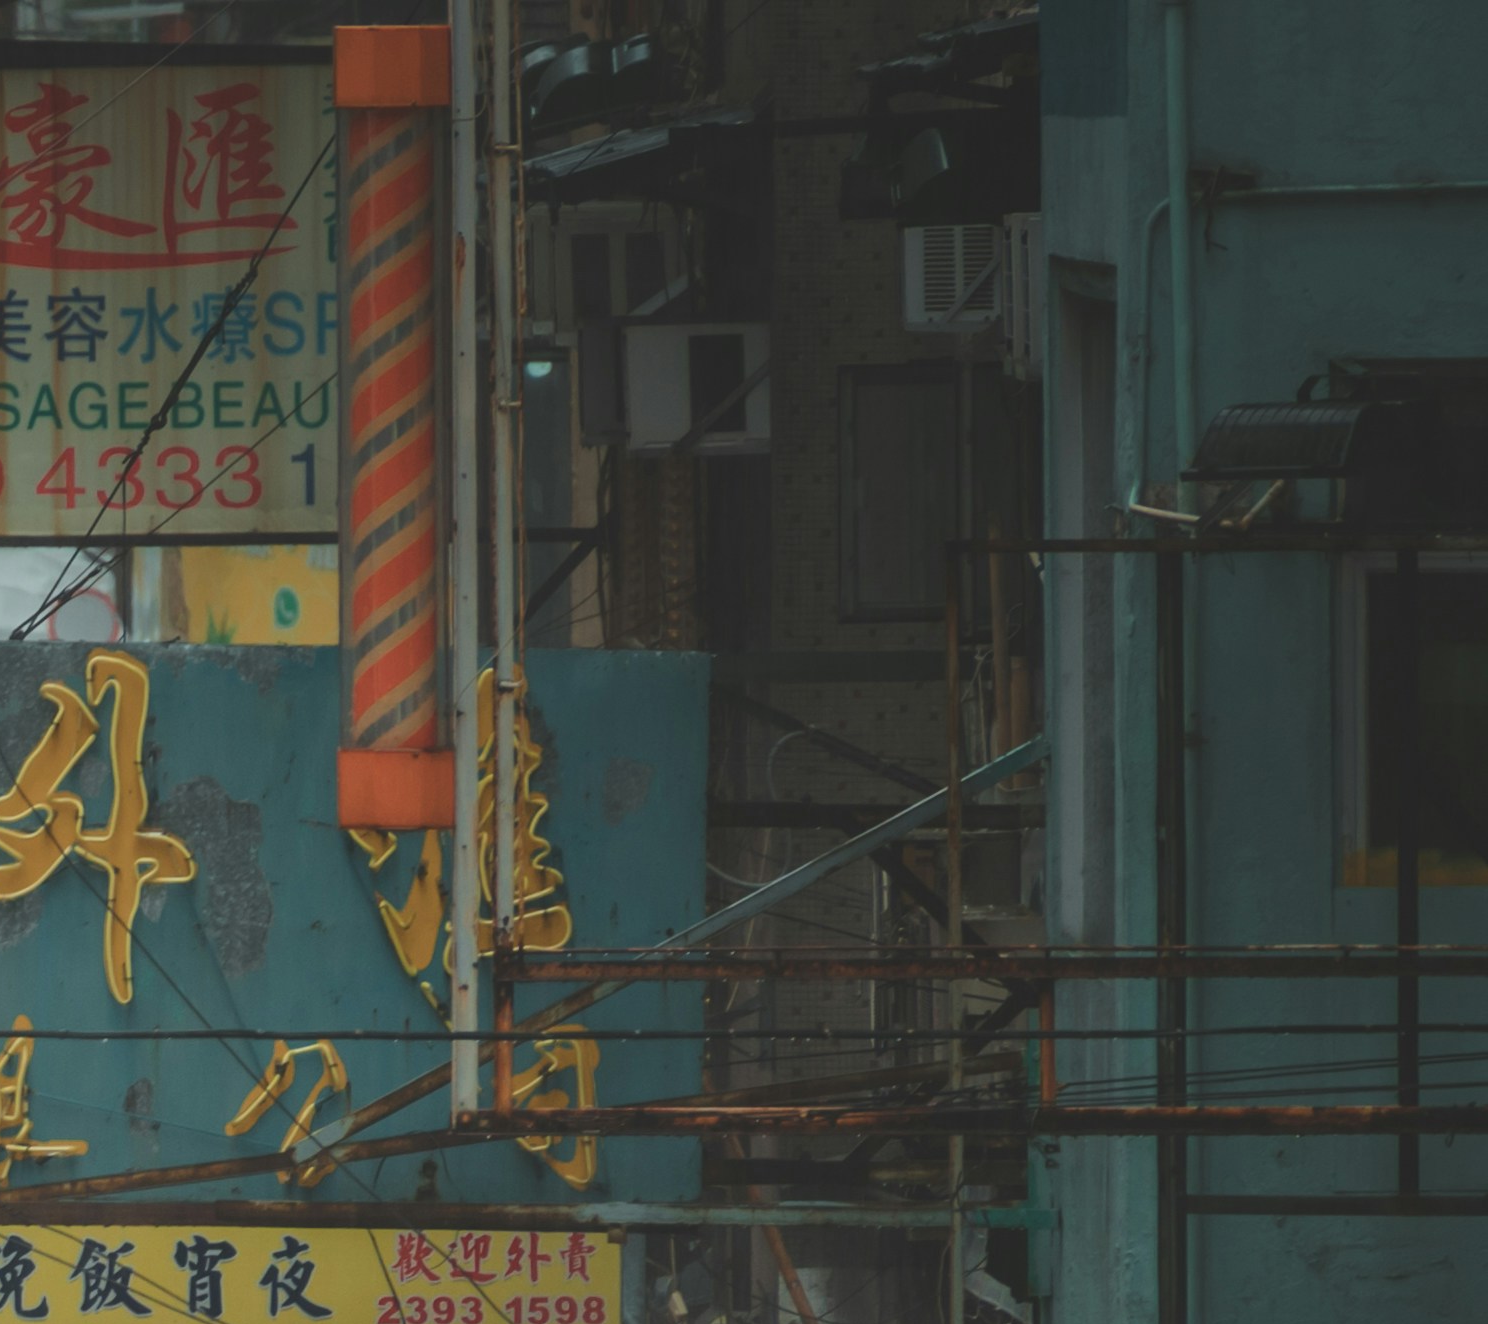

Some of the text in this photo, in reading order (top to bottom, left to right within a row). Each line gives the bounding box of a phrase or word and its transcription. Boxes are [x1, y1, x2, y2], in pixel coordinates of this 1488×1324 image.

[169, 378, 331, 431] BEAU
[36, 445, 264, 510] 4333
[390, 1230, 599, 1283] 歡迎外賣
